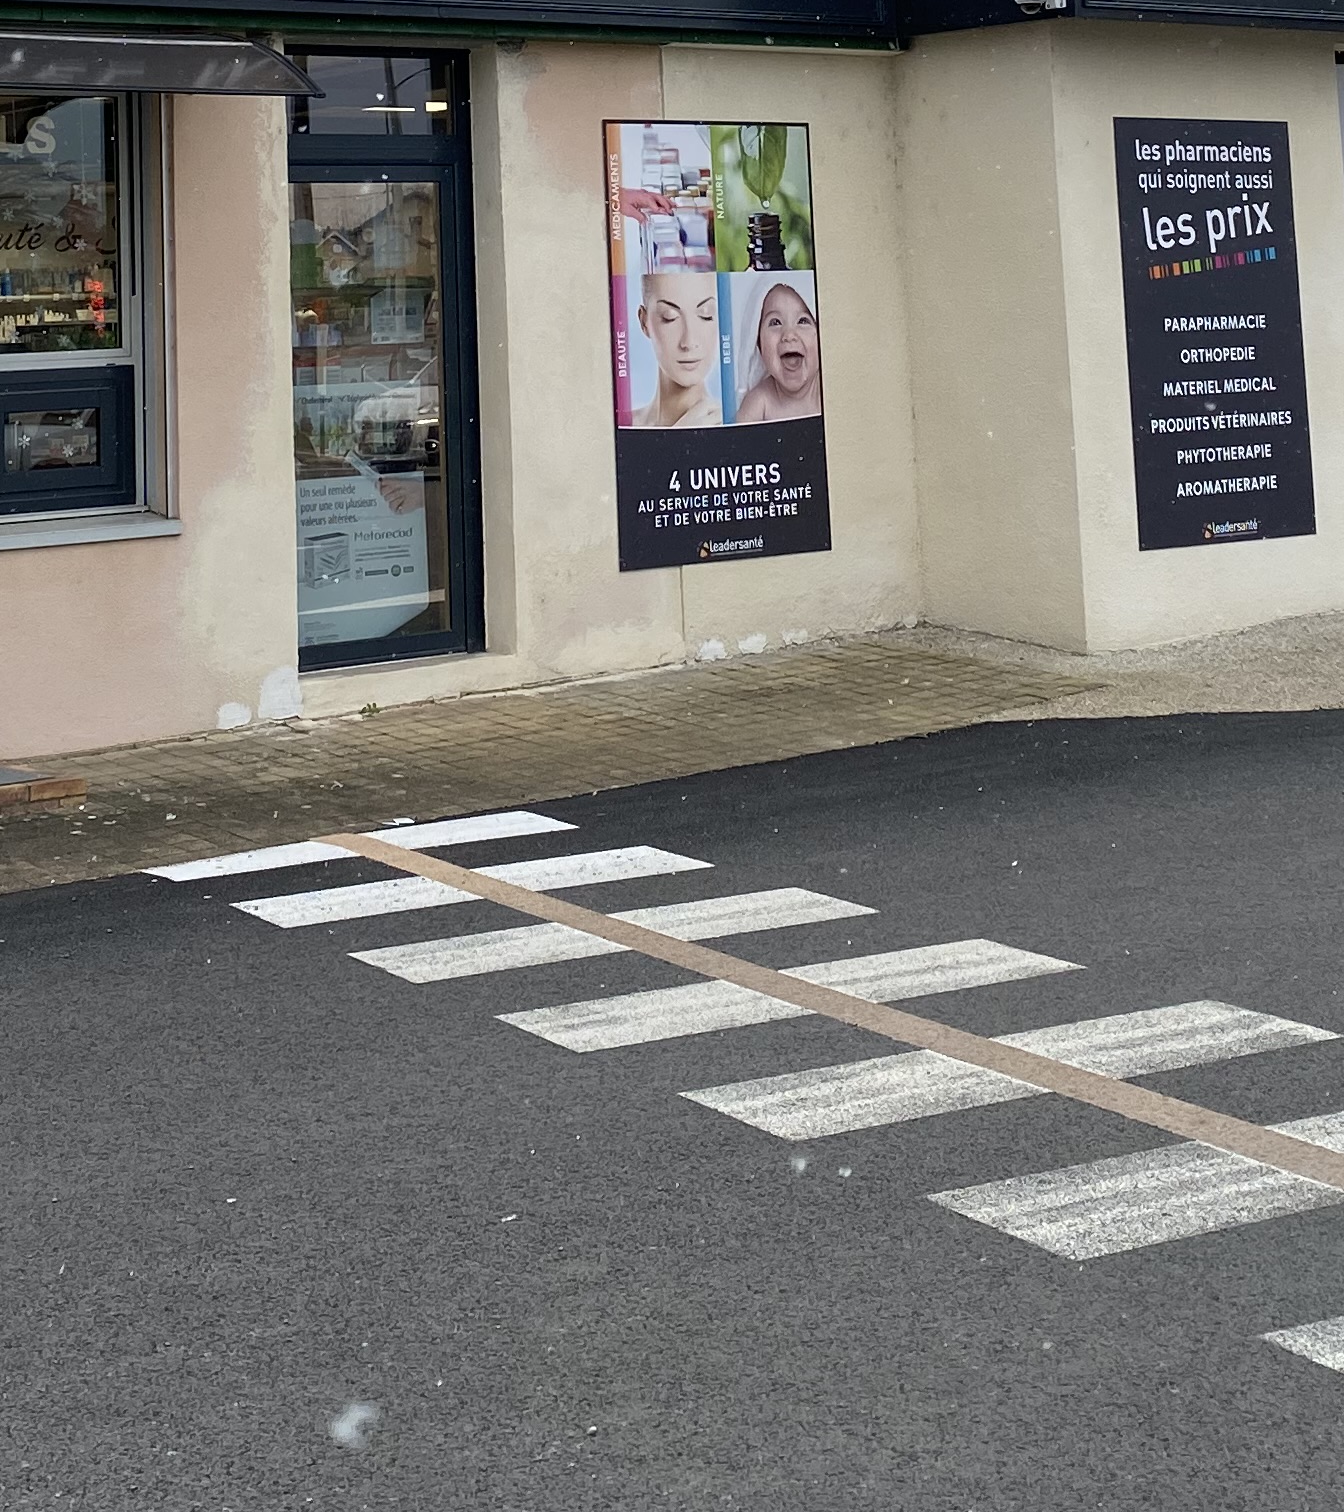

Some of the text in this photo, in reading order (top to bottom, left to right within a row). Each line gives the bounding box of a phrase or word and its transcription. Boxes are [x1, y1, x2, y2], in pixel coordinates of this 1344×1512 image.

[1135, 138, 1272, 166] les pharmaciens
[1138, 168, 1273, 194] qui soignent aussi
[609, 152, 622, 241] MEDICAMENTS
[716, 173, 726, 220] NATURE
[1142, 192, 1274, 254] les prix
[1163, 314, 1267, 332] PARAPHARMACIE
[1180, 346, 1256, 364] ORTHOPEDIE
[1163, 376, 1277, 397] MATERIEL MEDICAL
[1150, 409, 1292, 434] PRODUITS VÉTÉRINAIRES
[1177, 443, 1272, 465] PHYTOTHERAPIE
[669, 462, 782, 492] 4 UNIVERS
[1176, 474, 1278, 498] AROMATHERAPIE
[299, 484, 356, 498] Un seul remède
[637, 482, 812, 514] AU SERVICE DE VOTRE SANTÉ
[299, 497, 378, 515] pour une ou plusieurs
[655, 501, 799, 528] ET DE VOTRE BIEN-ÊTRE
[300, 516, 327, 527] valeurs
